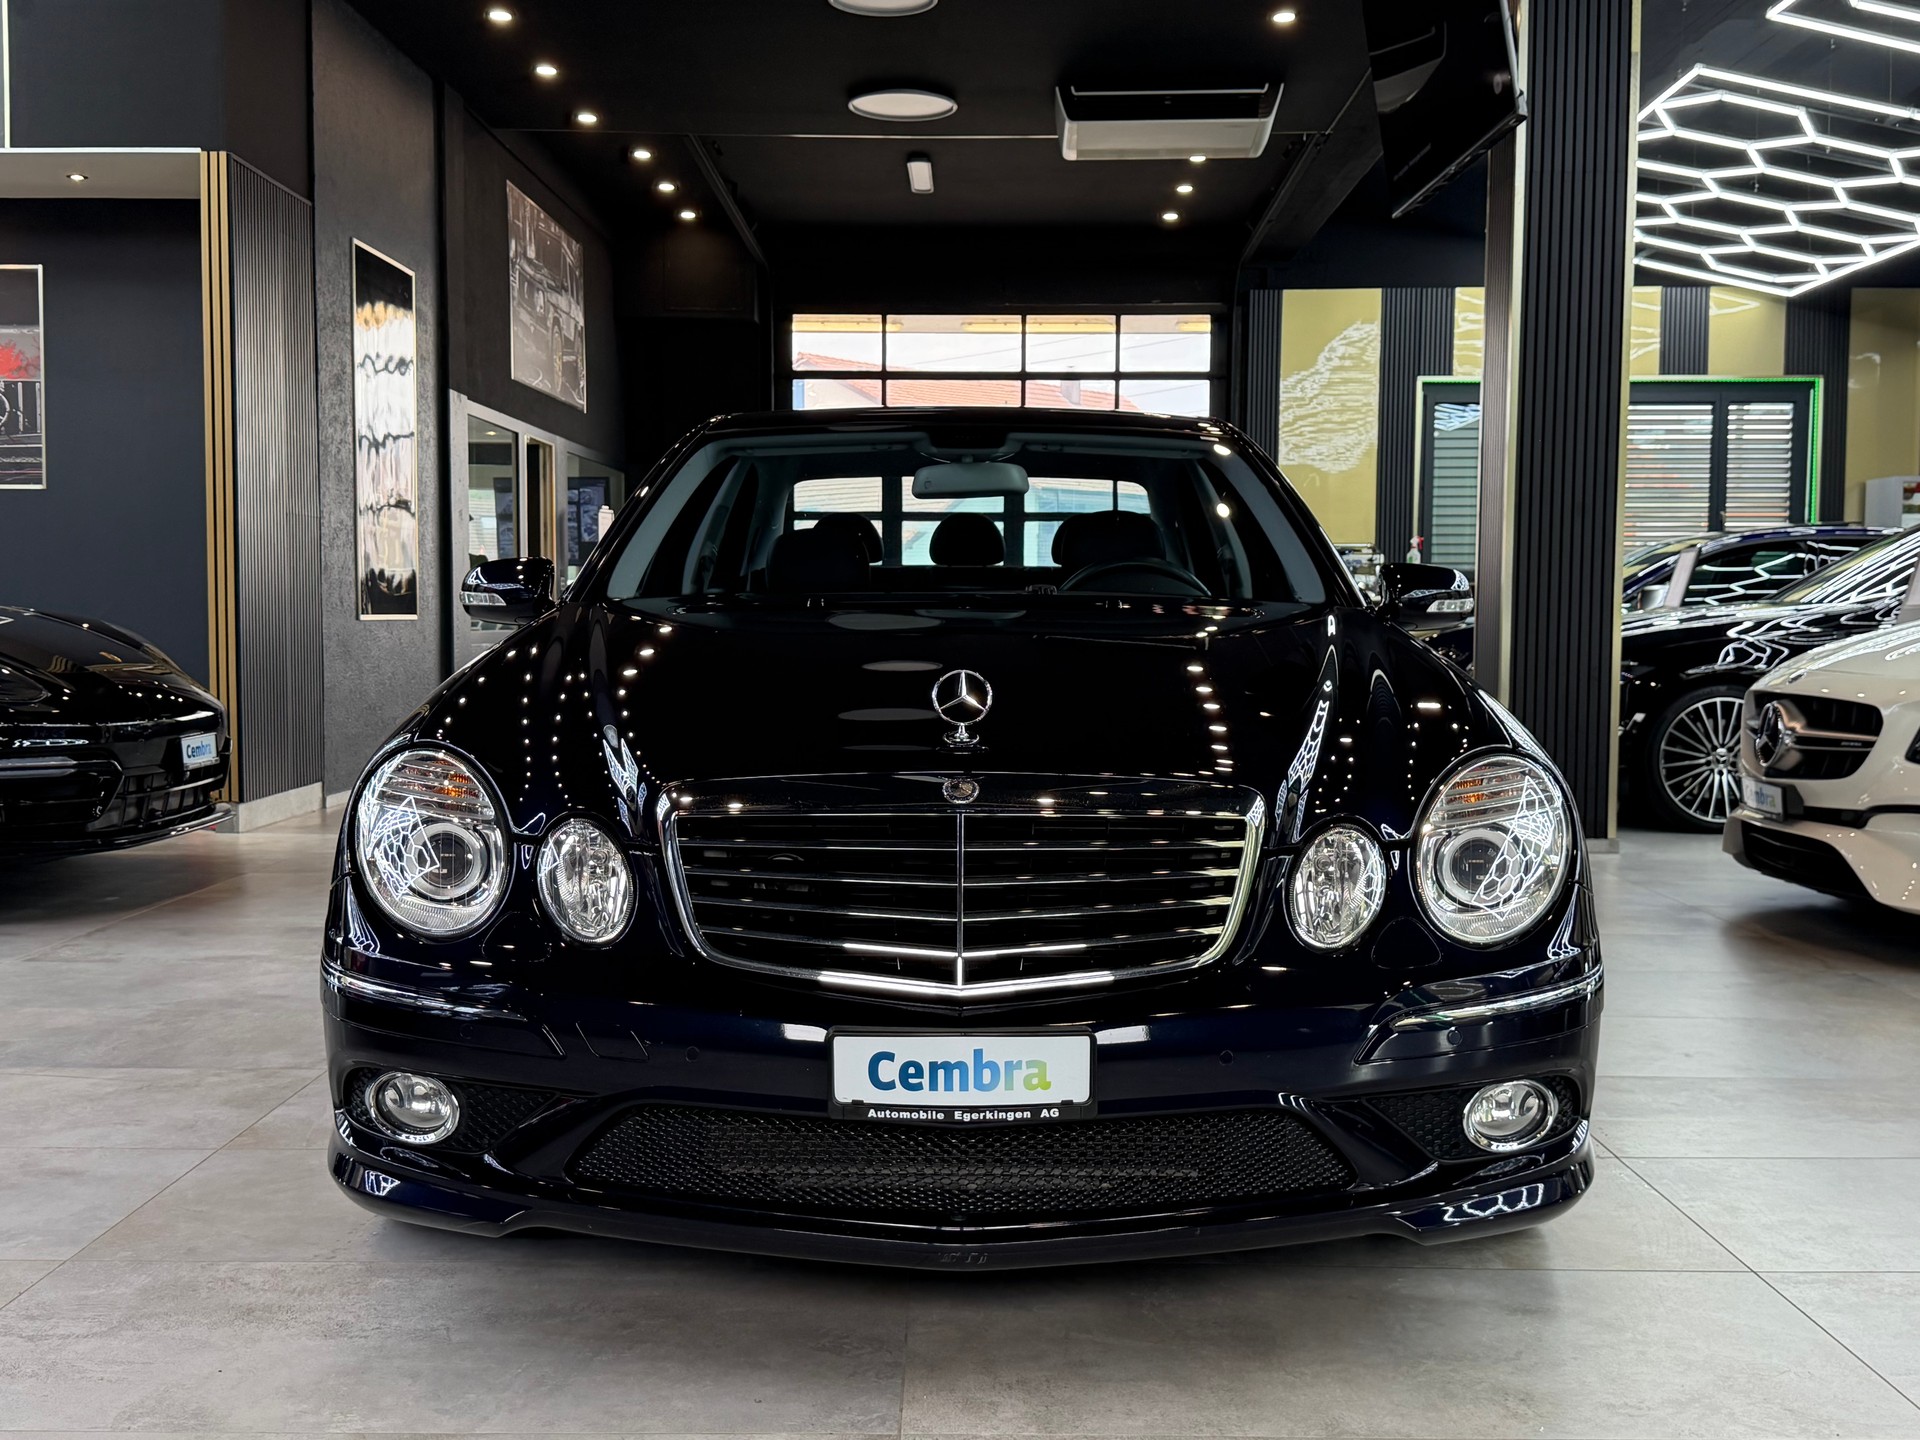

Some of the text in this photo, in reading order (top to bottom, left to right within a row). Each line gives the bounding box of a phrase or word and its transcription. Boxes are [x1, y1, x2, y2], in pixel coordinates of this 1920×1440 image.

[186, 740, 212, 759] Cembra
[867, 1048, 1051, 1092] Cembra
[867, 1108, 1060, 1122] Automobile Egerkingen AG
